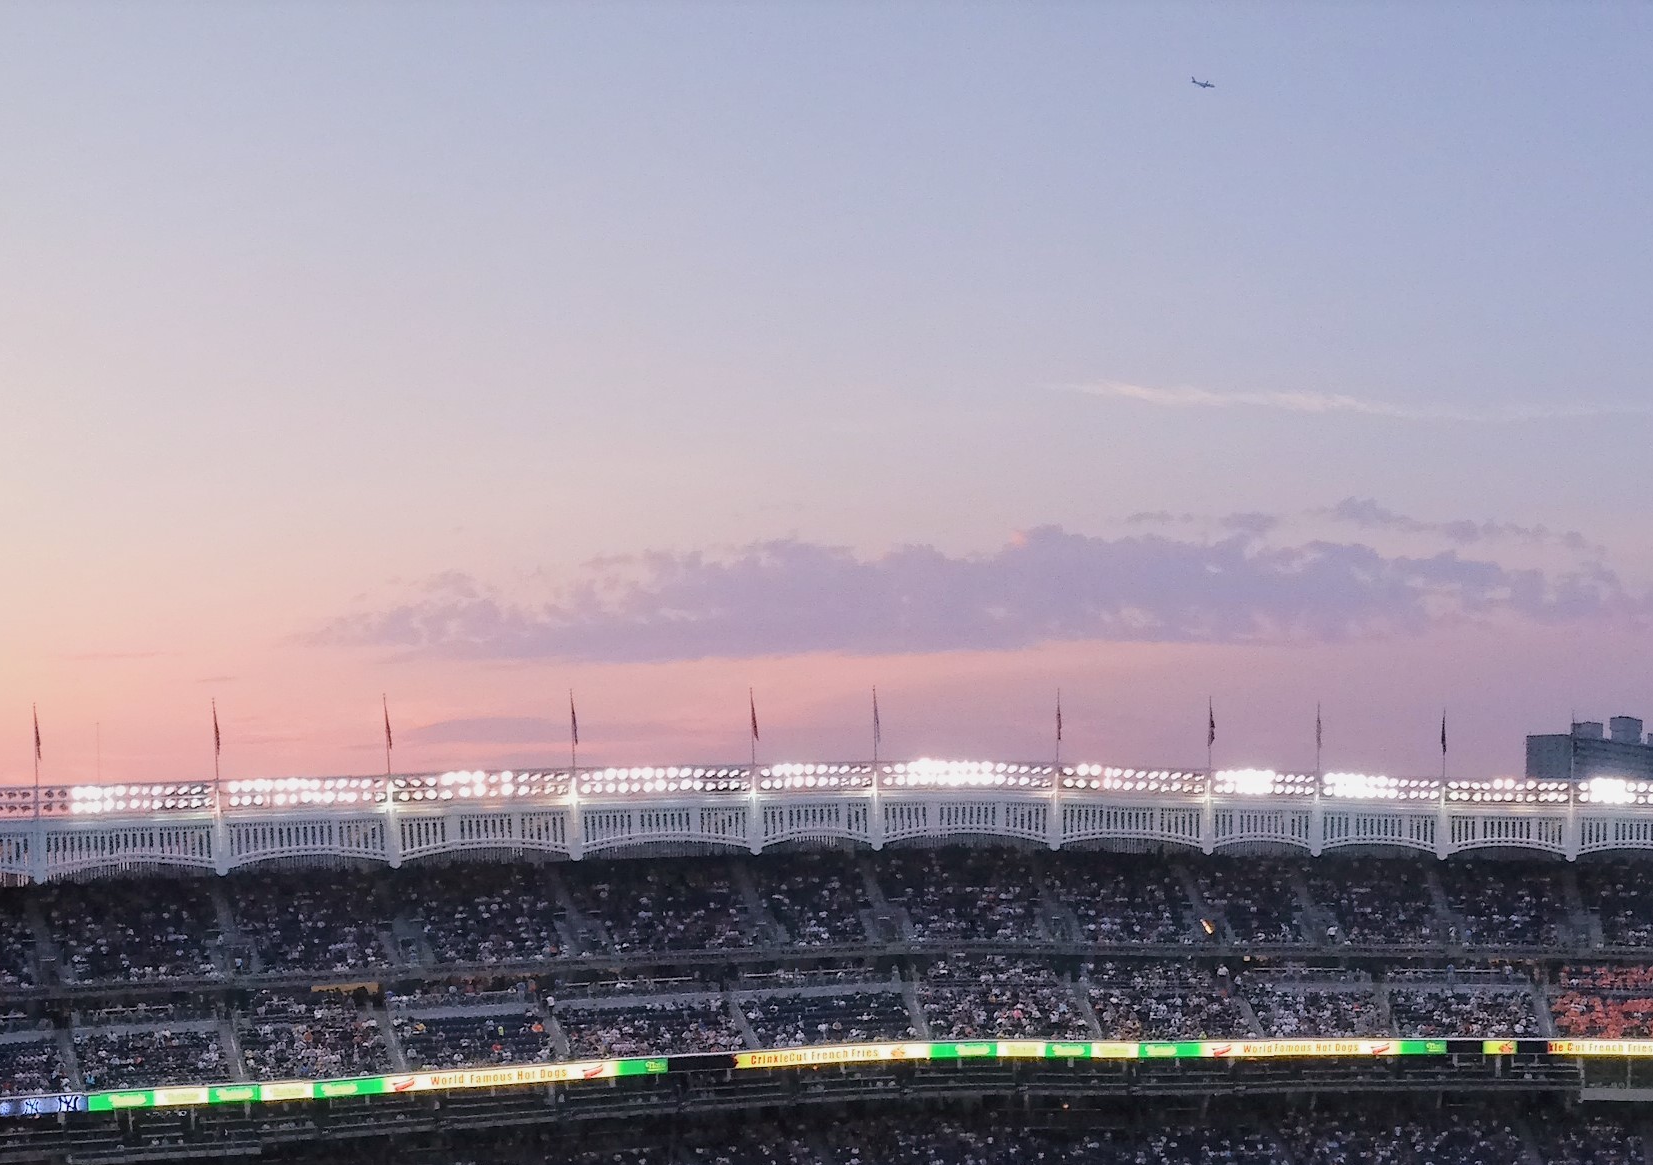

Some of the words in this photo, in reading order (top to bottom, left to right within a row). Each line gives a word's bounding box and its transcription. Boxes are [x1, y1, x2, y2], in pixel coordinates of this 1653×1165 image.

[811, 1049, 848, 1061] French
[851, 1048, 879, 1059] Fries
[1243, 1043, 1272, 1054] World
[1274, 1043, 1312, 1053] Famous
[1334, 1042, 1359, 1053] Dogs
[430, 1074, 464, 1086] World
[470, 1071, 513, 1085] Famous
[517, 1069, 536, 1081] Hot
[540, 1067, 568, 1080] Dogs
